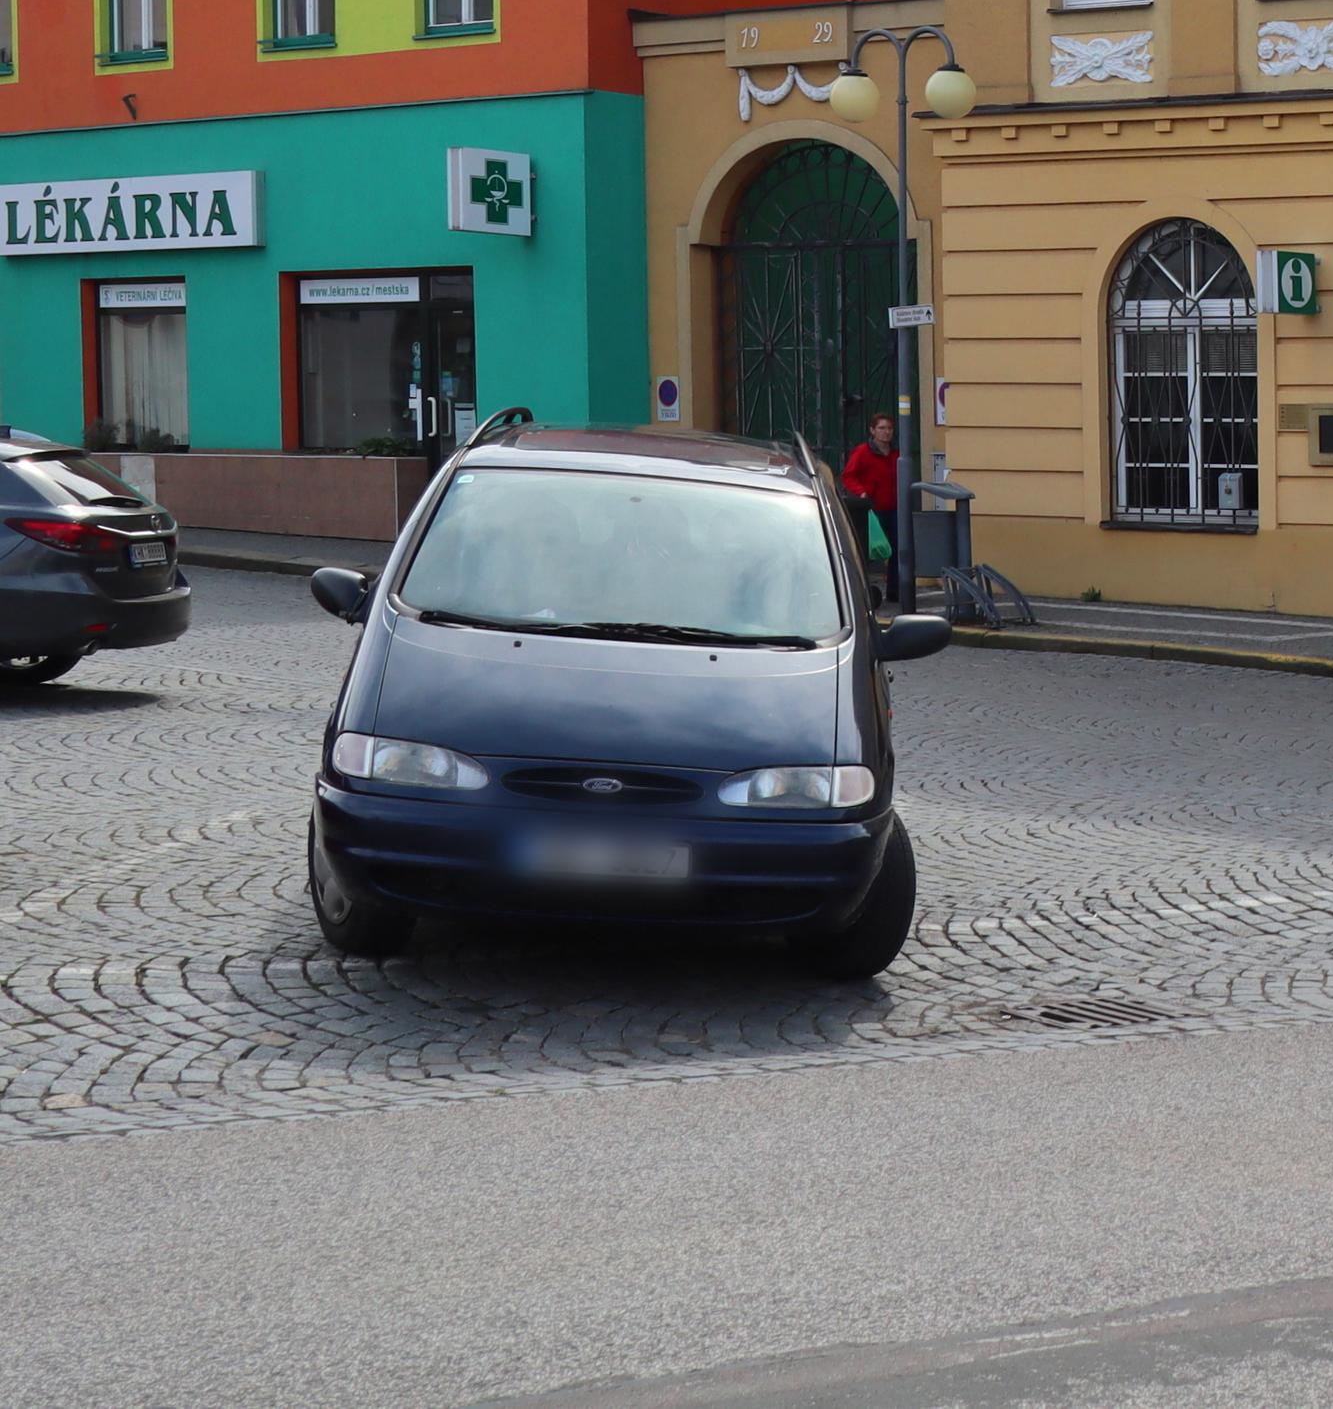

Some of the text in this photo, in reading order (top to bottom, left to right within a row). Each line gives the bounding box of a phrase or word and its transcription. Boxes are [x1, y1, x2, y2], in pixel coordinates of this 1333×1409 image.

[740, 26, 759, 48] 19
[5, 181, 238, 245] LÉKÁRNA
[115, 288, 158, 302] VETERINÁRNÍ
